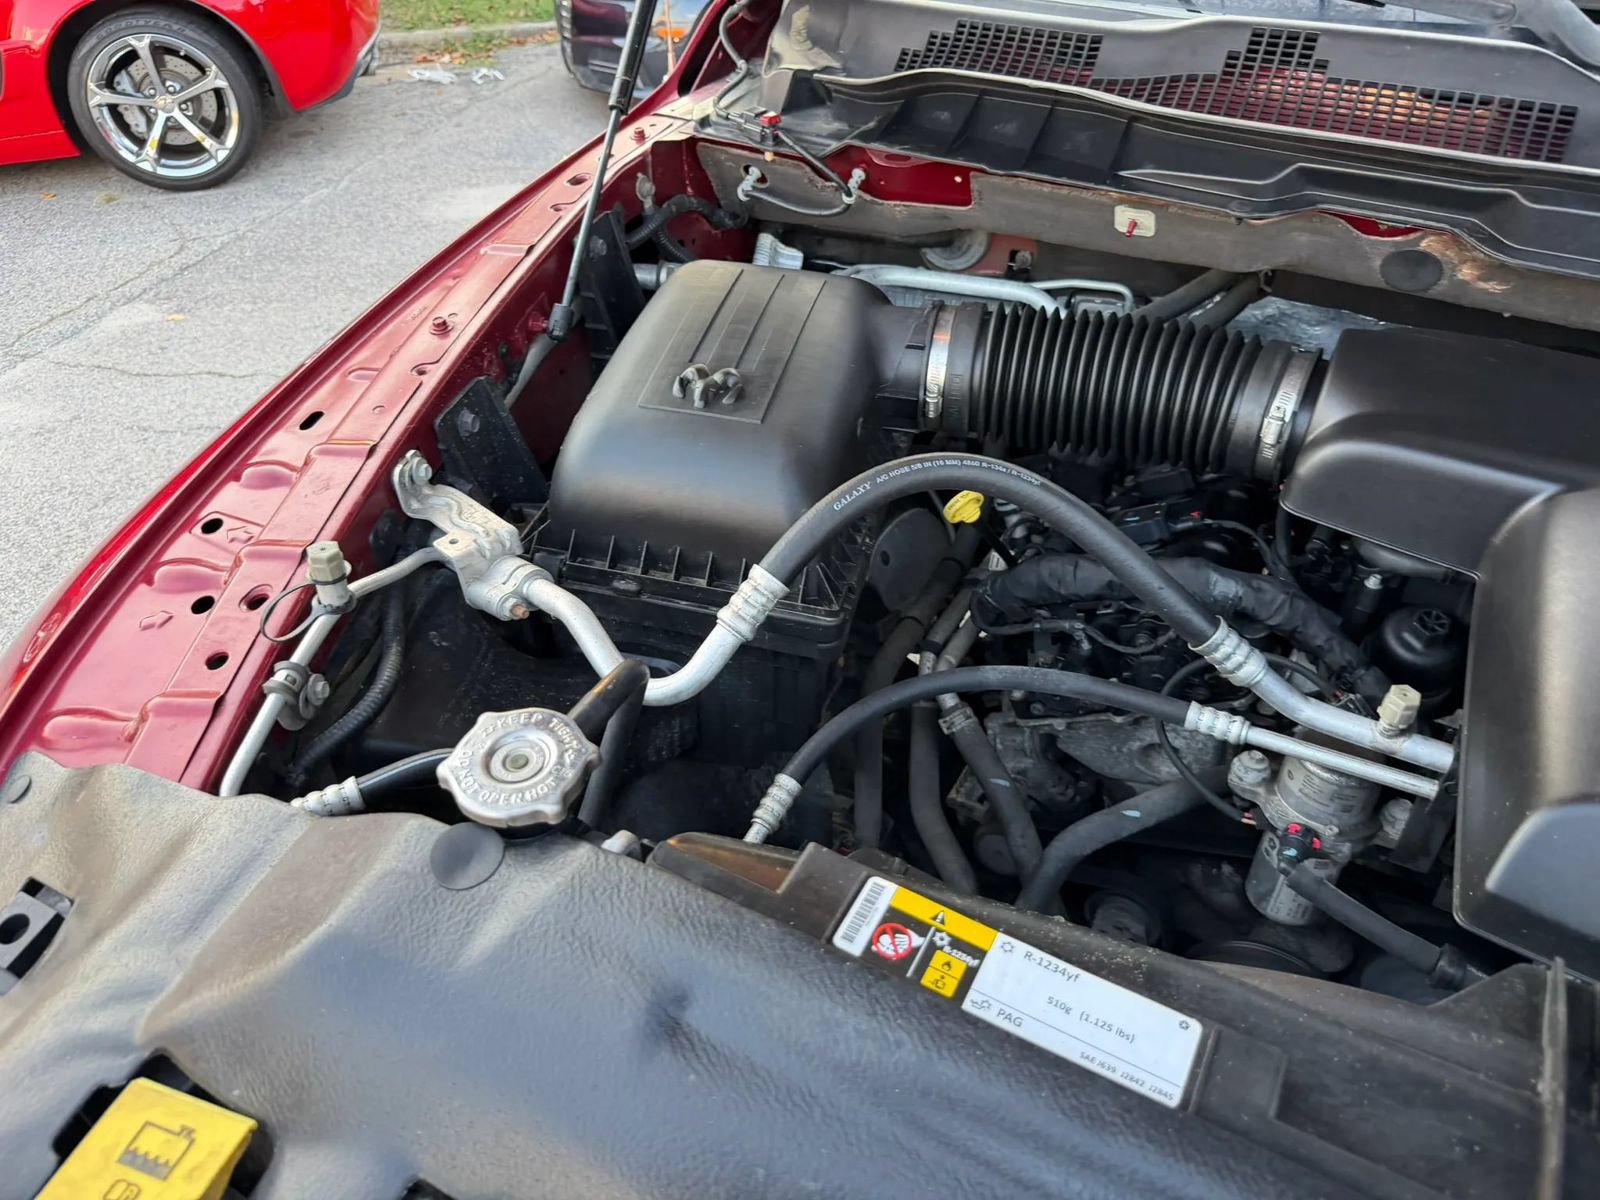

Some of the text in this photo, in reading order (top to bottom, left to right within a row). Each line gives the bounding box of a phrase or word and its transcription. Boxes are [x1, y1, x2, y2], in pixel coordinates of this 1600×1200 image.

[833, 481, 872, 511] GALAXY
[875, 473, 889, 484] A/C
[889, 466, 911, 479] HOSE
[923, 461, 932, 469] IN
[933, 459, 945, 469] (16
[495, 712, 582, 749] KEEP TIGHT
[458, 768, 481, 795] NOT
[524, 777, 557, 802] HOT
[1023, 950, 1081, 983] R-1234yf
[996, 1008, 1025, 1028] PAG
[1047, 996, 1136, 1044] 510g (1.125 lbs)
[1079, 1051, 1097, 1065] SAE
